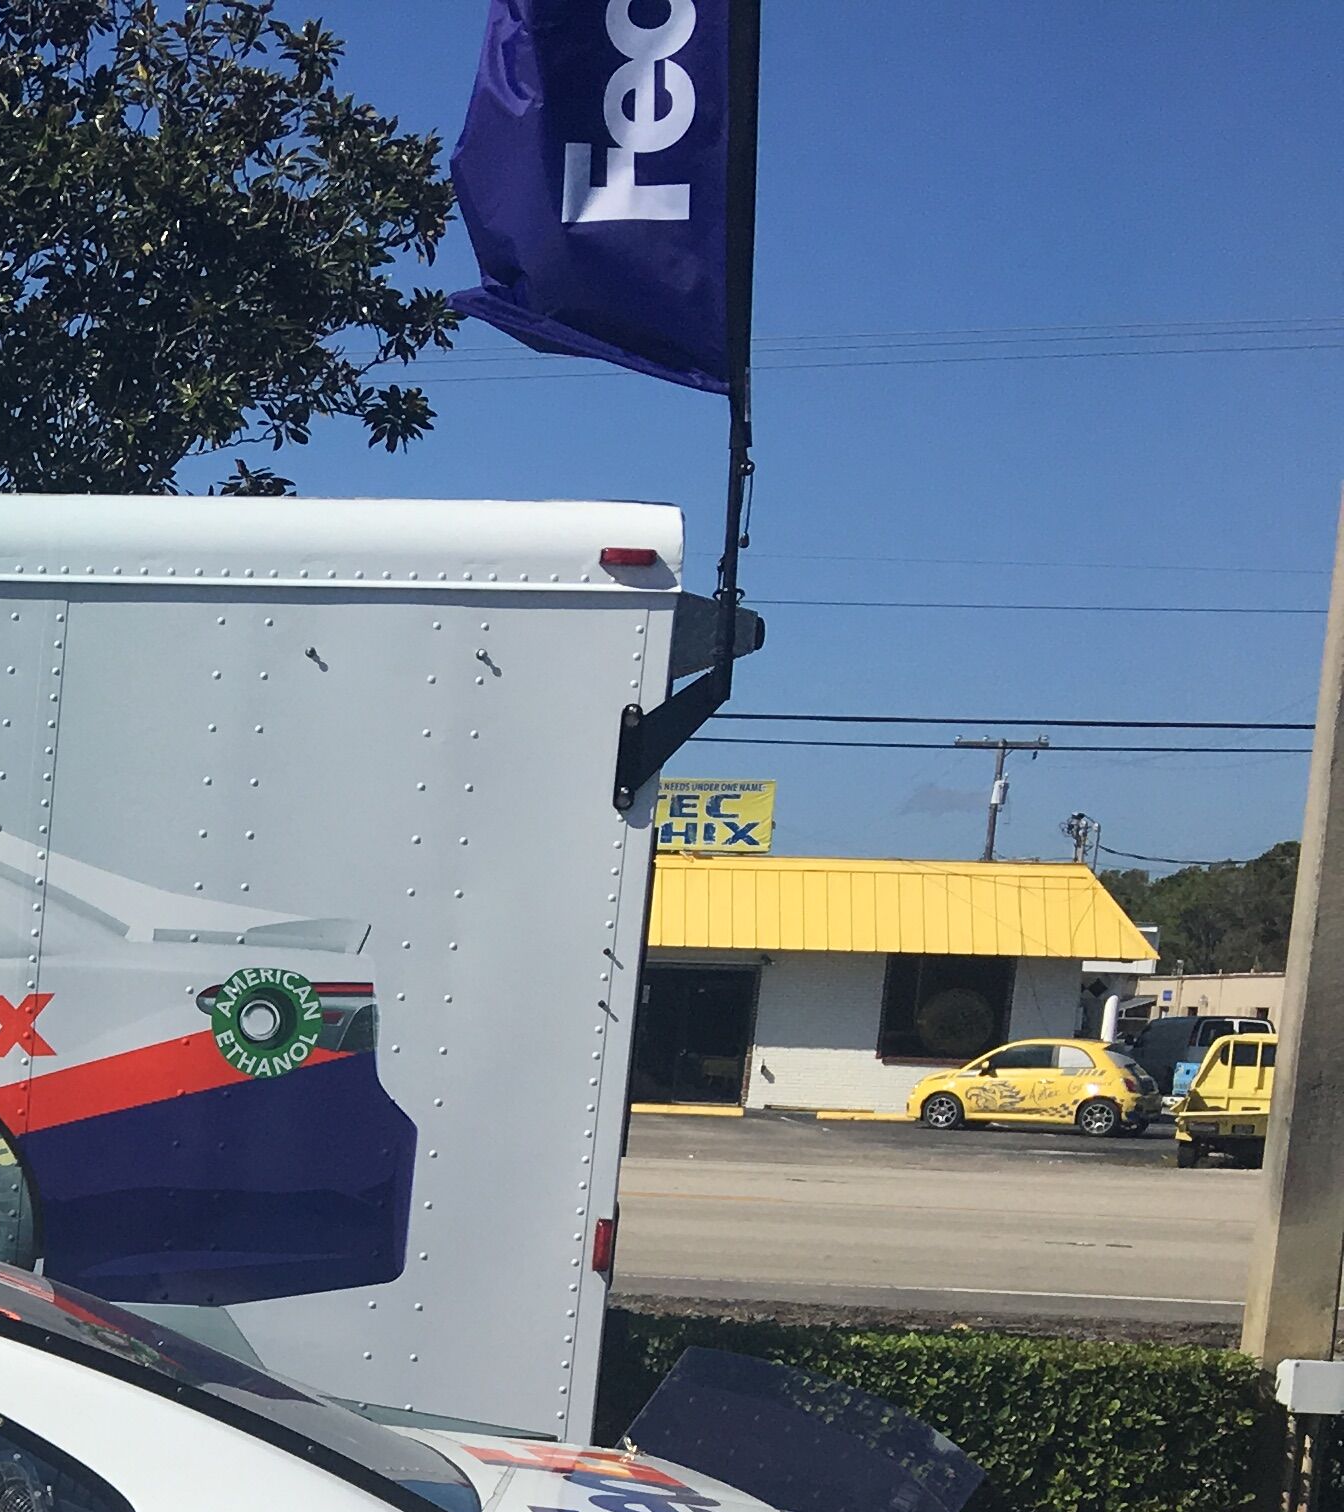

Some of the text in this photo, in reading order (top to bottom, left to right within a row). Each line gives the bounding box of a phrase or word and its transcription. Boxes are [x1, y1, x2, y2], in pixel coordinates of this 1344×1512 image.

[664, 782, 690, 792] NEEDS
[692, 782, 720, 792] UNDER
[720, 783, 738, 793] ONE
[216, 968, 321, 1021] AMERICAN
[215, 1029, 318, 1077] ETHANOL
